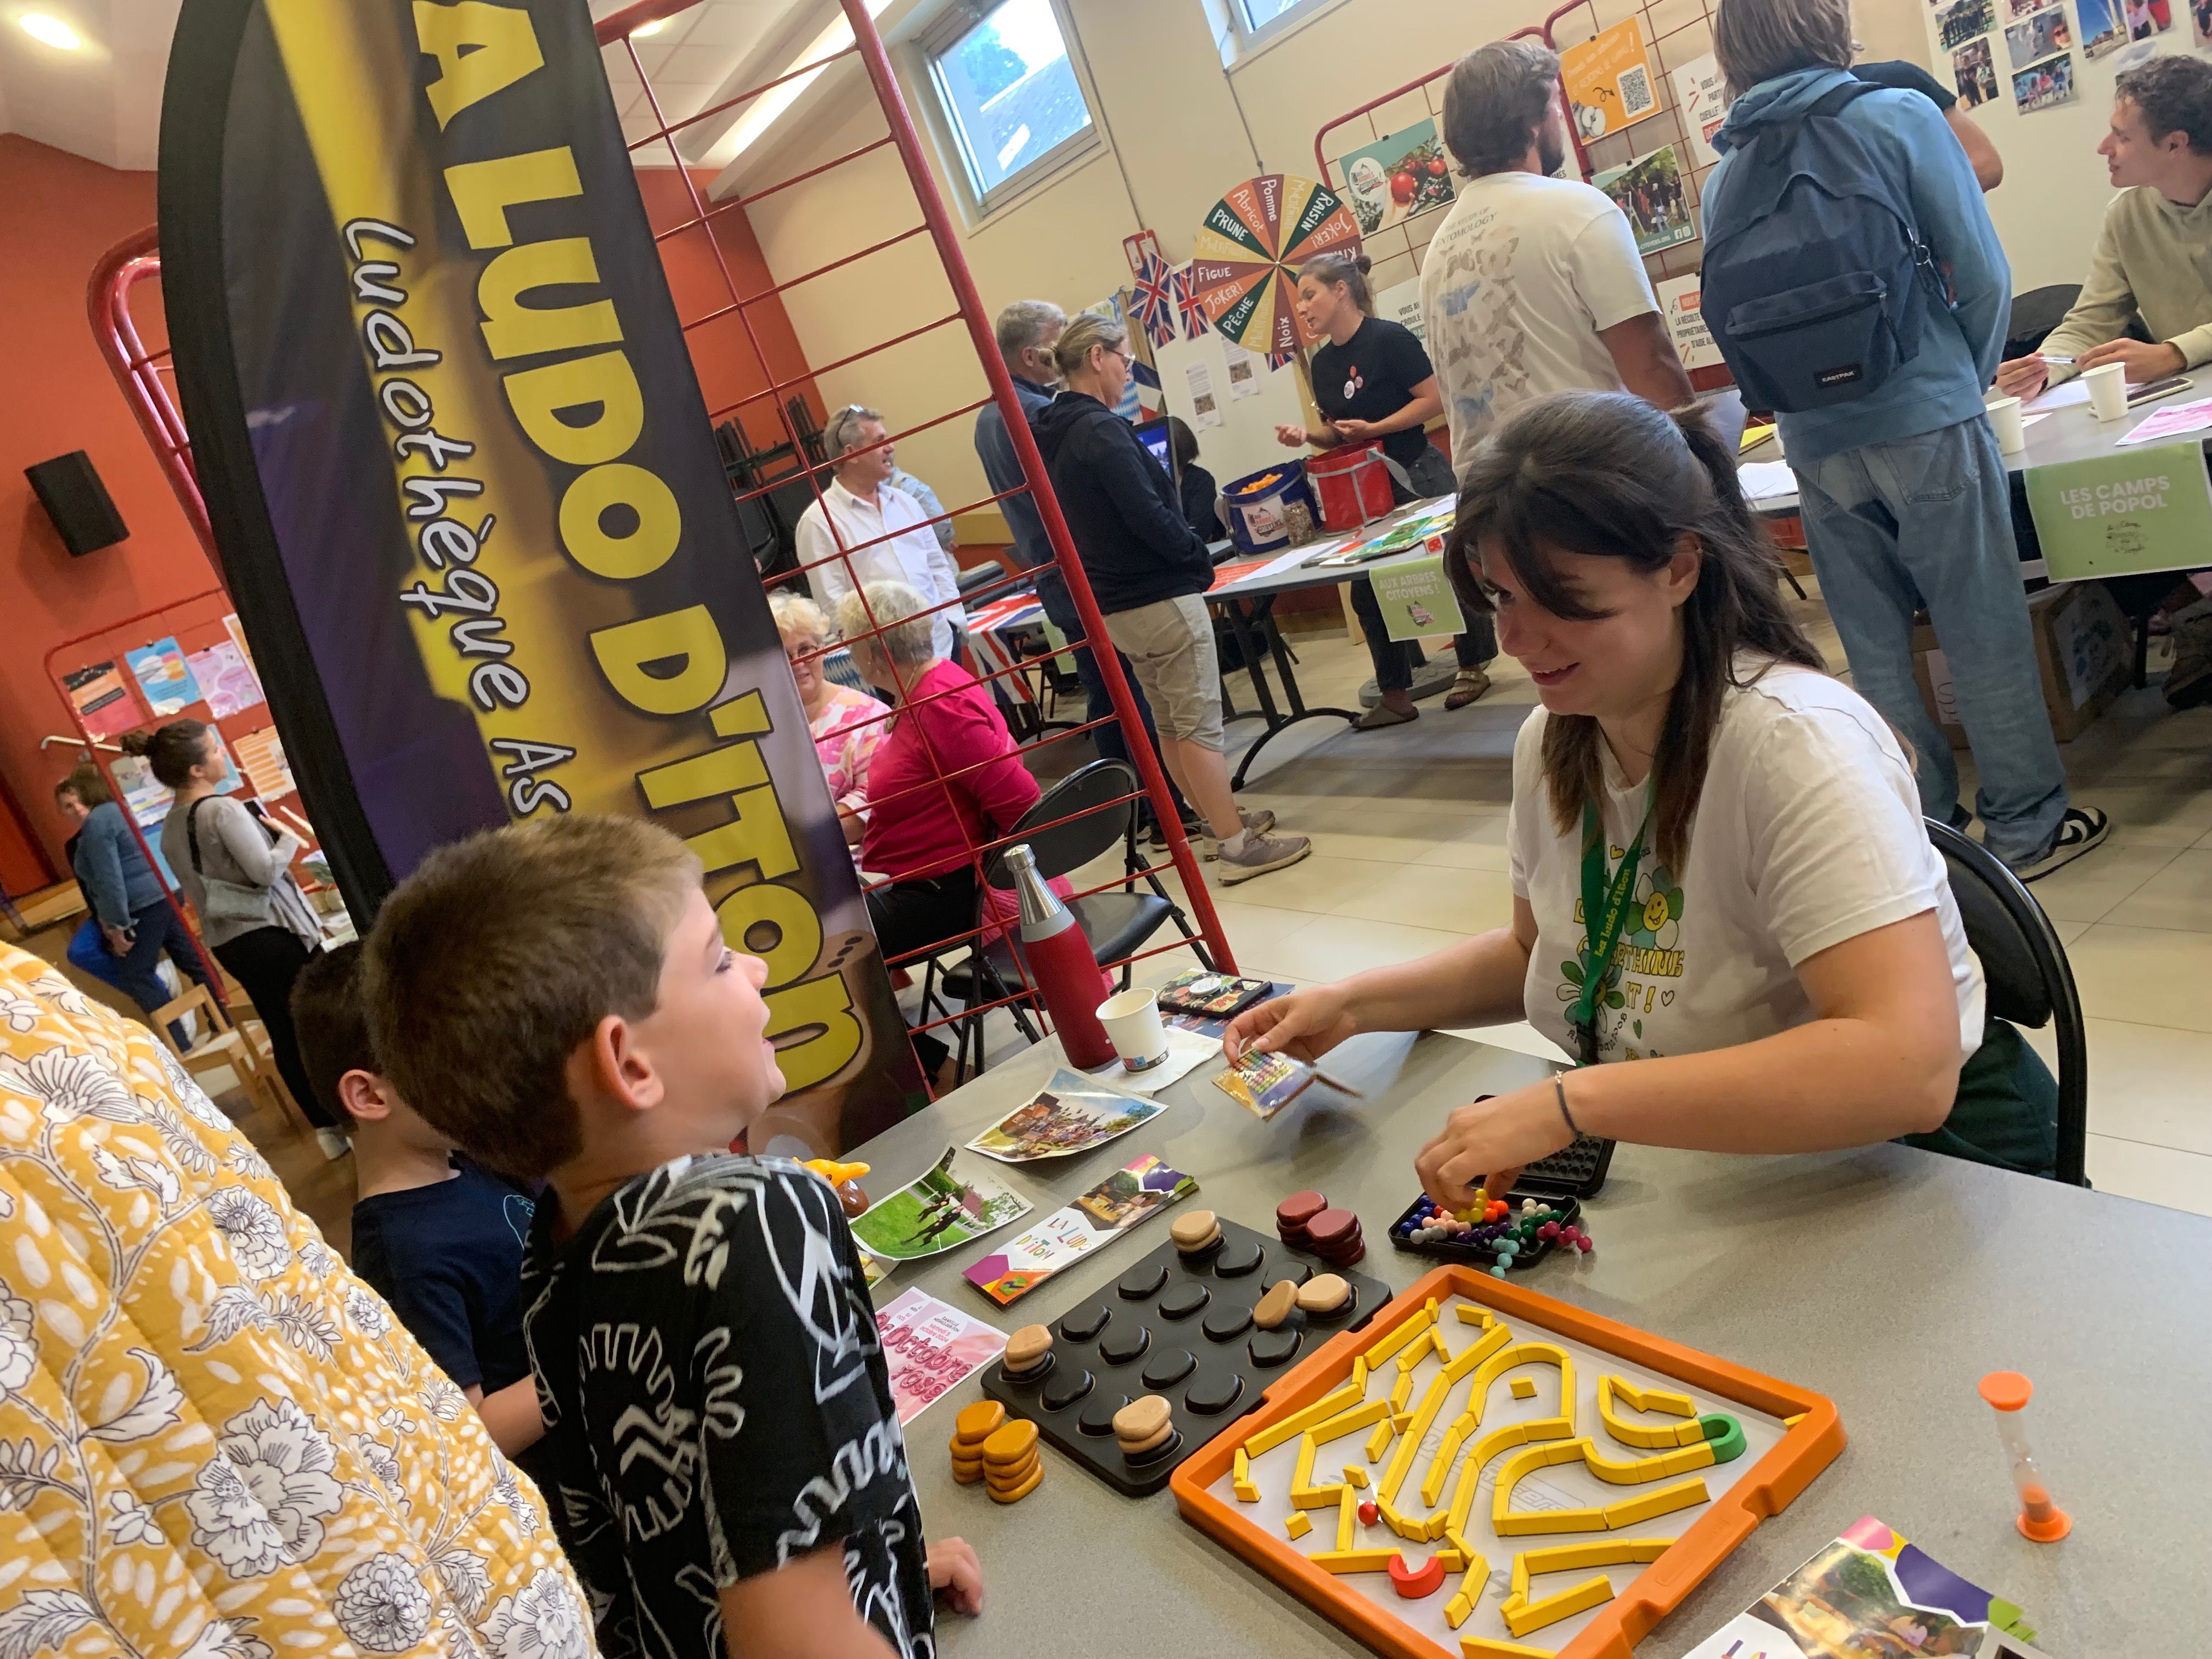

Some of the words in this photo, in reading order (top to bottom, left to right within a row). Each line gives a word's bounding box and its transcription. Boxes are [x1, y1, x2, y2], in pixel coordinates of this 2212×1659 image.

[1232, 189, 1265, 233] Abricot
[1261, 179, 1277, 222] Pomme
[1212, 208, 1249, 241] PRUNE
[1222, 297, 1254, 334] PÊCHE
[1398, 304, 1413, 316] VOUS
[1675, 318, 1680, 326] LA
[1278, 317, 1294, 348] Noix
[1822, 370, 1854, 382] EASTPAK
[341, 218, 531, 713] Ludothèque
[2060, 488, 2092, 505] LES
[2096, 475, 2170, 499] CAMPS
[2070, 503, 2096, 520] DE
[2098, 493, 2168, 515] POPOL
[1379, 578, 1398, 590] AUX
[1386, 584, 1434, 601] CITOYENS
[1600, 907, 1618, 939] Ludo
[1594, 940, 1607, 958] La
[1625, 981, 1642, 1009] IT
[1047, 1217, 1069, 1230] LA
[1057, 1227, 1092, 1251] LUDO
[920, 1326, 937, 1336] octobre
[935, 1334, 949, 1342] 2024
[929, 1323, 946, 1334] samedi
[883, 1324, 974, 1384] Octobre
[890, 1364, 947, 1403] rose
